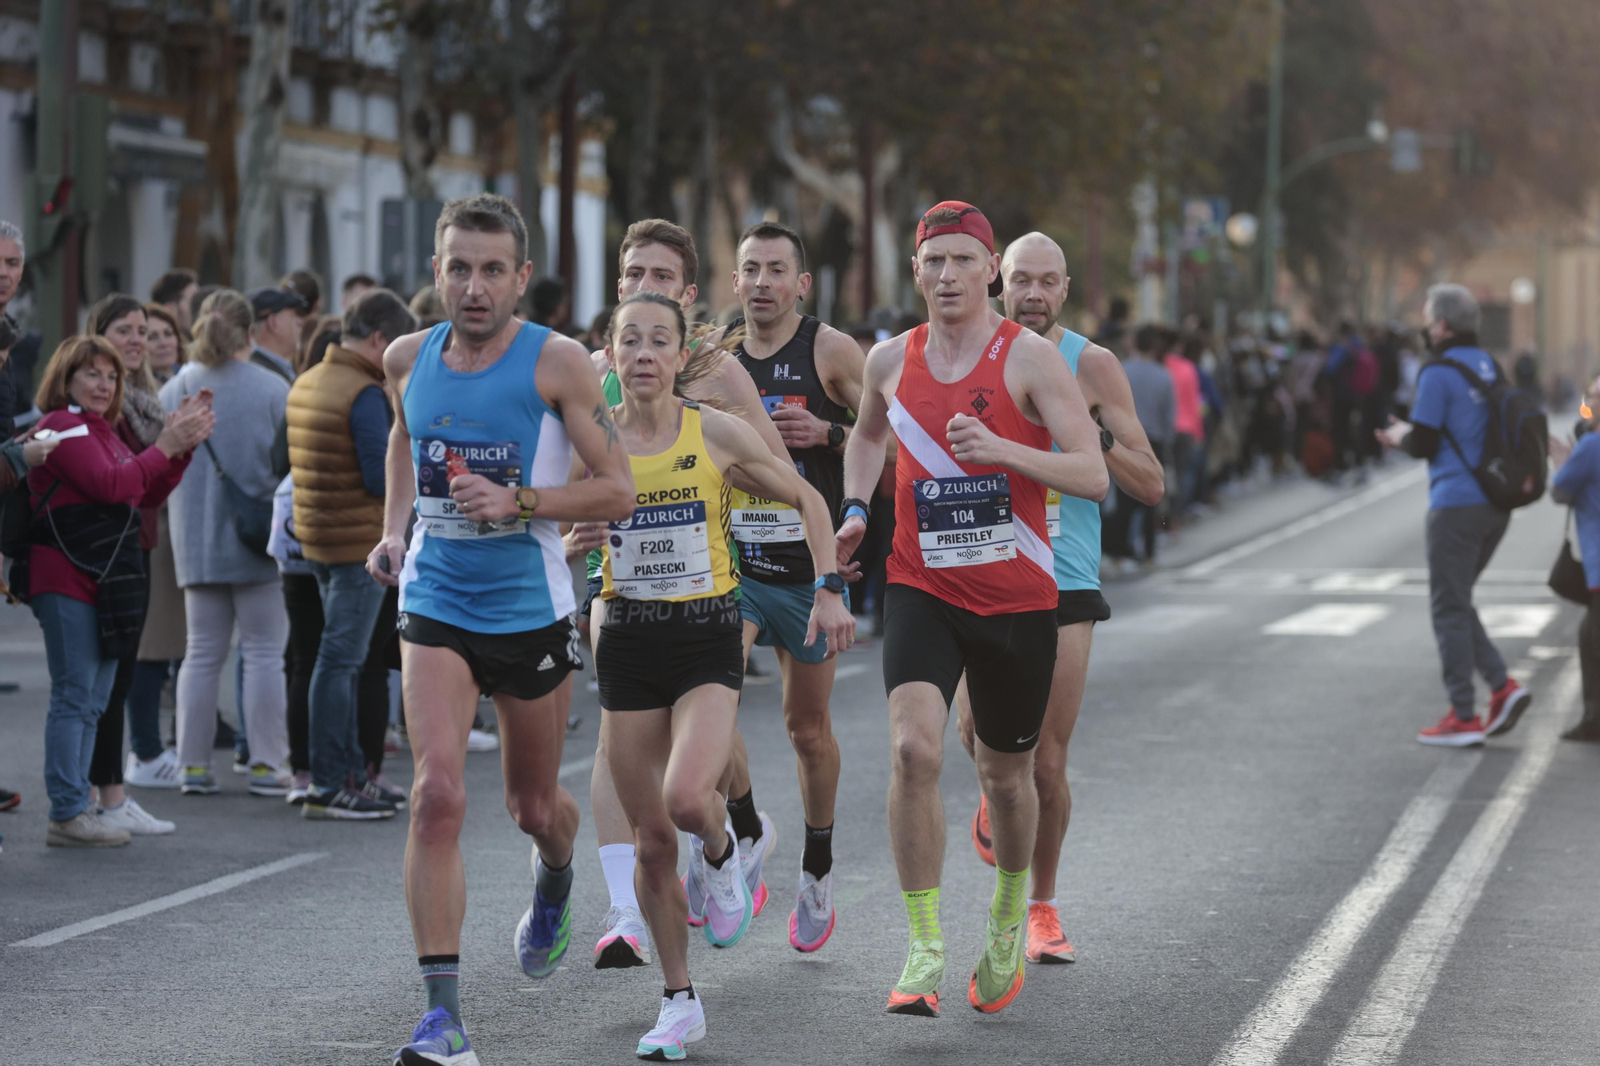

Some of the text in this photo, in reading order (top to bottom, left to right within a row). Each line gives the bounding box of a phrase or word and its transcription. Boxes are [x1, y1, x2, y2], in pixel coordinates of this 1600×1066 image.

[988, 336, 1004, 360] soar
[968, 386, 995, 395] Salford
[636, 486, 698, 504] CKPORT
[943, 479, 997, 495] ZURICH
[636, 507, 694, 525] ZURICH
[742, 513, 780, 522] IMANOL
[951, 509, 975, 524] 104
[937, 529, 993, 546] PRIESTLEY
[640, 540, 674, 555] F202
[634, 562, 686, 576] PIASECKI
[626, 602, 673, 624] PRO
